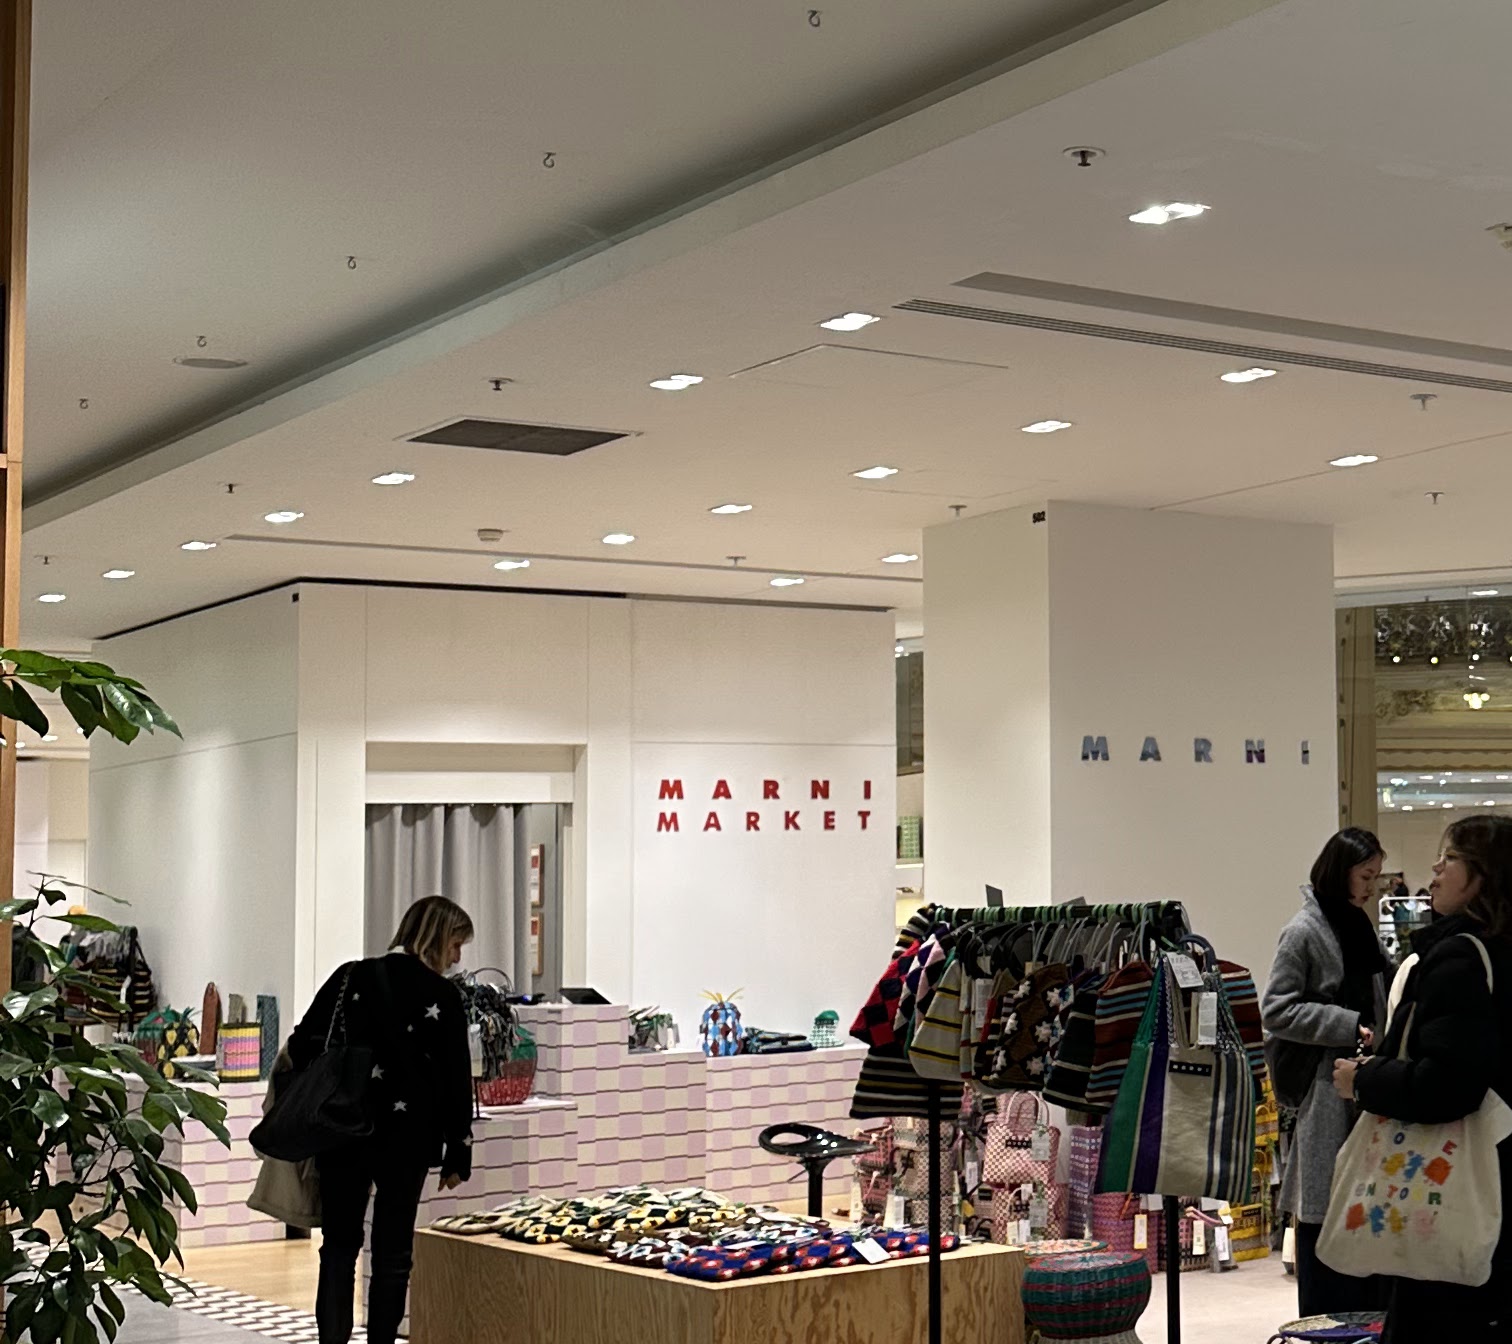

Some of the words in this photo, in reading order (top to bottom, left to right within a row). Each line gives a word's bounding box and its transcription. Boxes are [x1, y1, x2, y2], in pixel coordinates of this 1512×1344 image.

[1081, 735, 1309, 765] MARNI
[658, 779, 871, 800] MARNI
[657, 810, 871, 832] MARKET
